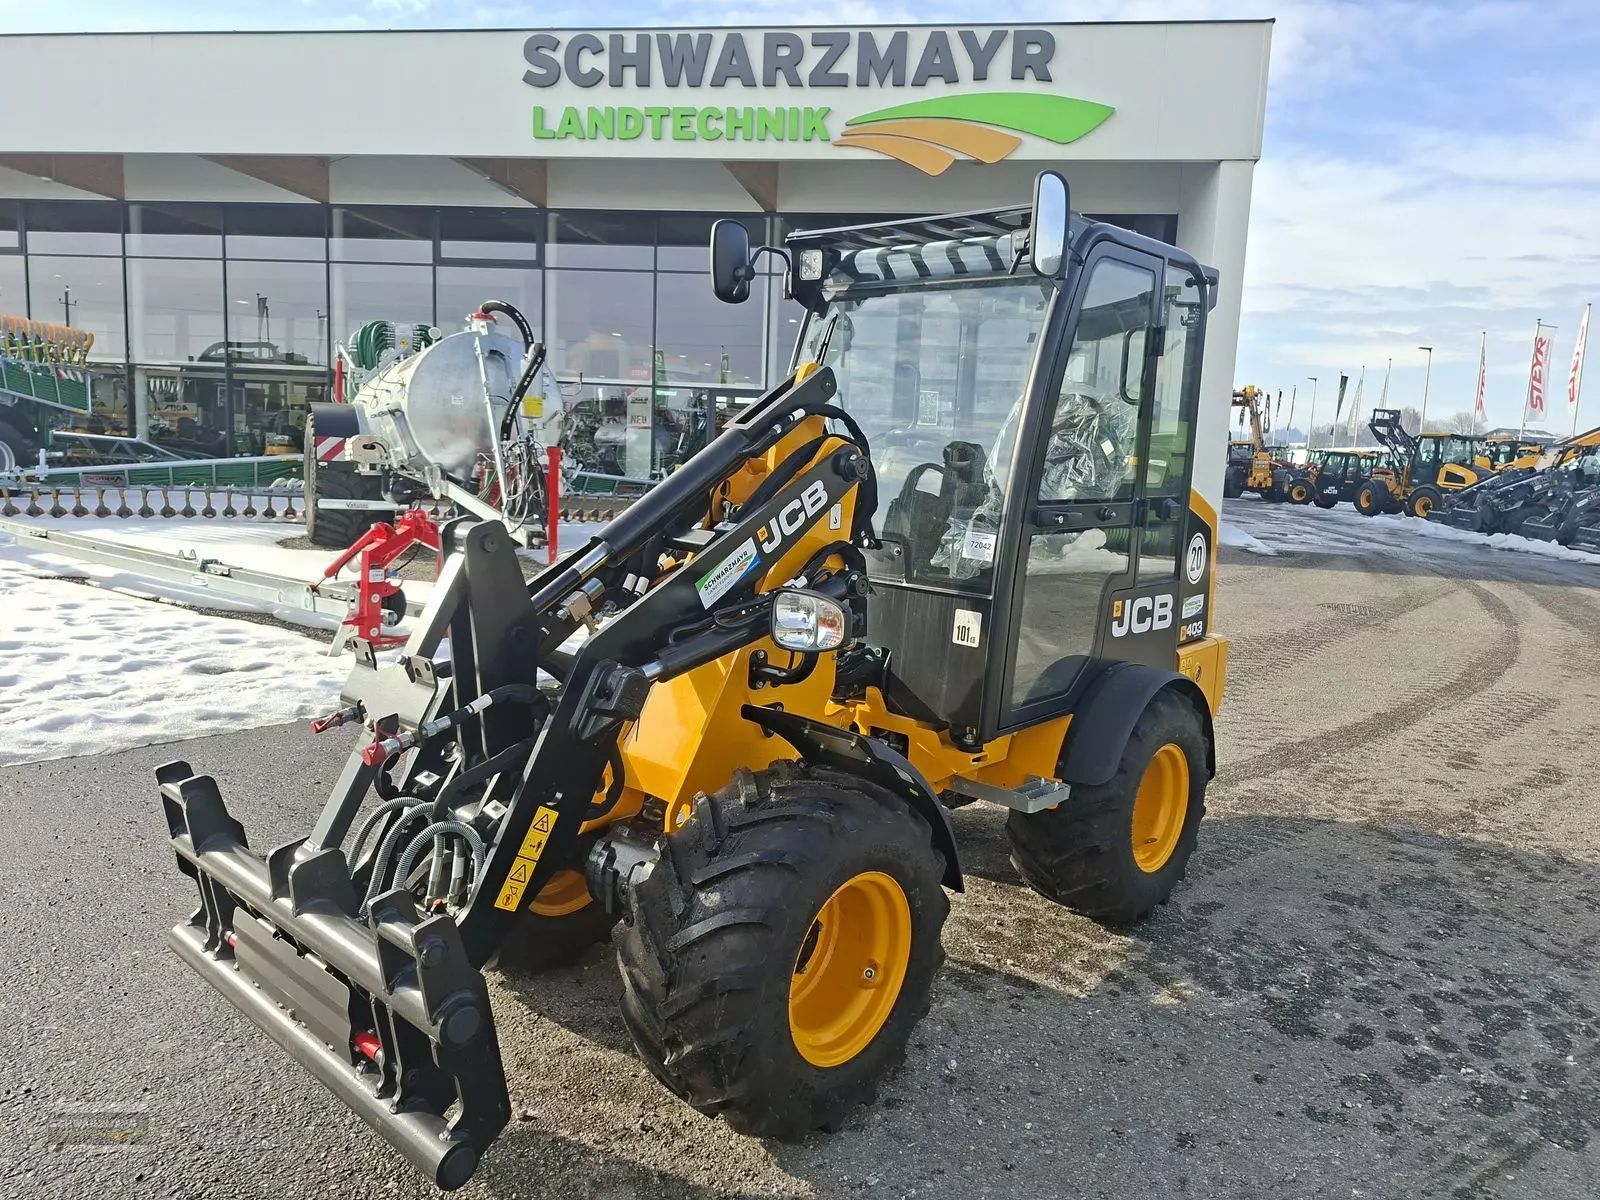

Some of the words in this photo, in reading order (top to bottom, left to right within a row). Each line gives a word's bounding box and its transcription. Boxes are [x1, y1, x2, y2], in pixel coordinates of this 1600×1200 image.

[522, 29, 1056, 88] SCHWARZMAYR
[532, 106, 831, 142] LANDTECHNIK
[1530, 336, 1546, 412] STEYR
[631, 415, 647, 424] NEU
[761, 479, 829, 554] JCB
[970, 540, 992, 551] 72042
[1190, 545, 1203, 572] 20
[703, 550, 748, 592] SCHWARZMAYR
[957, 624, 970, 642] 101
[1111, 593, 1174, 638] JCB
[1186, 621, 1203, 636] 403
